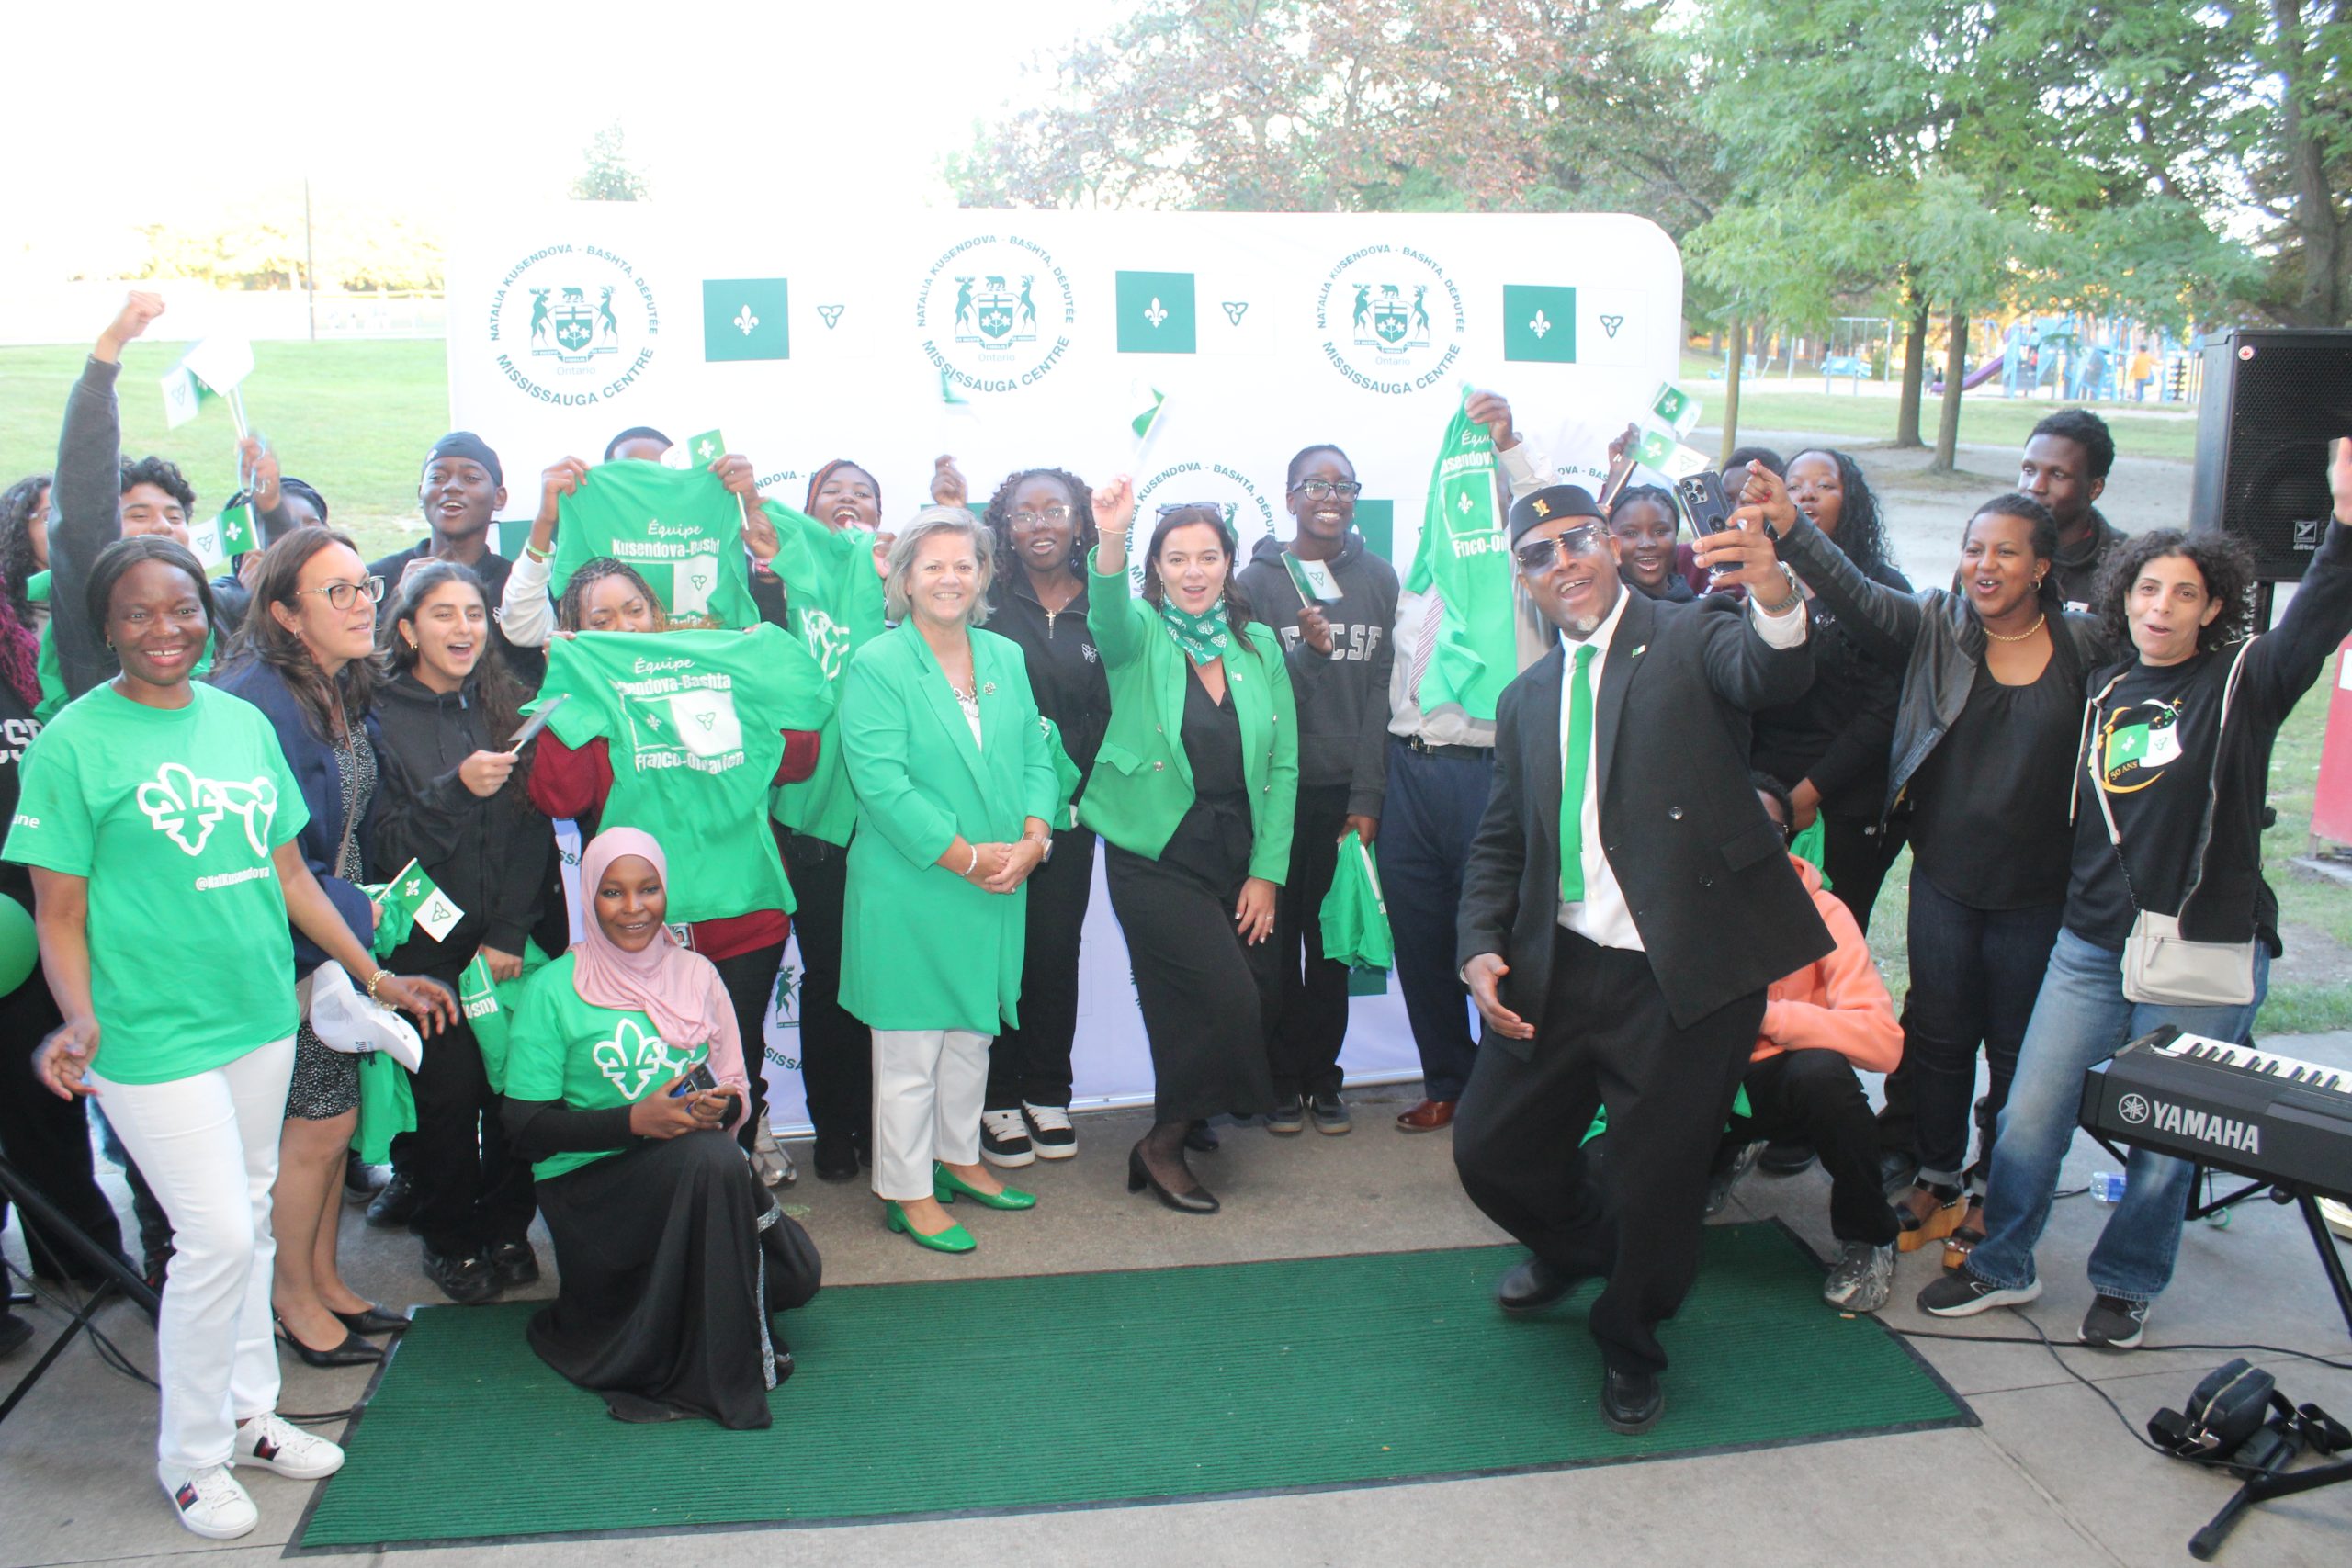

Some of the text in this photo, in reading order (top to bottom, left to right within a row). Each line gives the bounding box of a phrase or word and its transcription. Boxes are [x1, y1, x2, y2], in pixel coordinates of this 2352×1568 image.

[490, 289, 507, 341] NATALIA
[503, 244, 573, 288] KUSENDOVA
[586, 245, 633, 278] BASHTA,
[635, 277, 661, 335] DÉPUTÉE
[917, 277, 933, 327] NATALIA
[930, 235, 997, 276] KUSENDOVA
[1009, 235, 1052, 268] BASHTA,
[1053, 267, 1075, 324] DÉPUTÉE
[1317, 281, 1332, 329] NATALIA
[1329, 244, 1390, 279] KUSENDOVA
[1402, 246, 1442, 279] BASHTA,
[1444, 279, 1464, 333] DÉPUTÉE
[496, 347, 654, 406] MISSISSAUGA CENTRE
[557, 367, 595, 376] Ontario
[922, 335, 1069, 392] MISSISSAUGA CENTRE
[978, 353, 1015, 362] Ontario
[1322, 341, 1461, 395] MISSISSAUGA CENTRE
[1375, 356, 1410, 366] Ontario
[754, 470, 797, 491] NDOVA
[1137, 462, 1201, 502] KUSENDOVA
[1213, 463, 1255, 497] BASHTA,
[1255, 495, 1276, 536] DÉPUT
[647, 518, 704, 539] Équipe
[634, 657, 695, 674] Équipe
[2109, 761, 2138, 781] 50 ANS
[2153, 1100, 2259, 1155] YAMAHA
